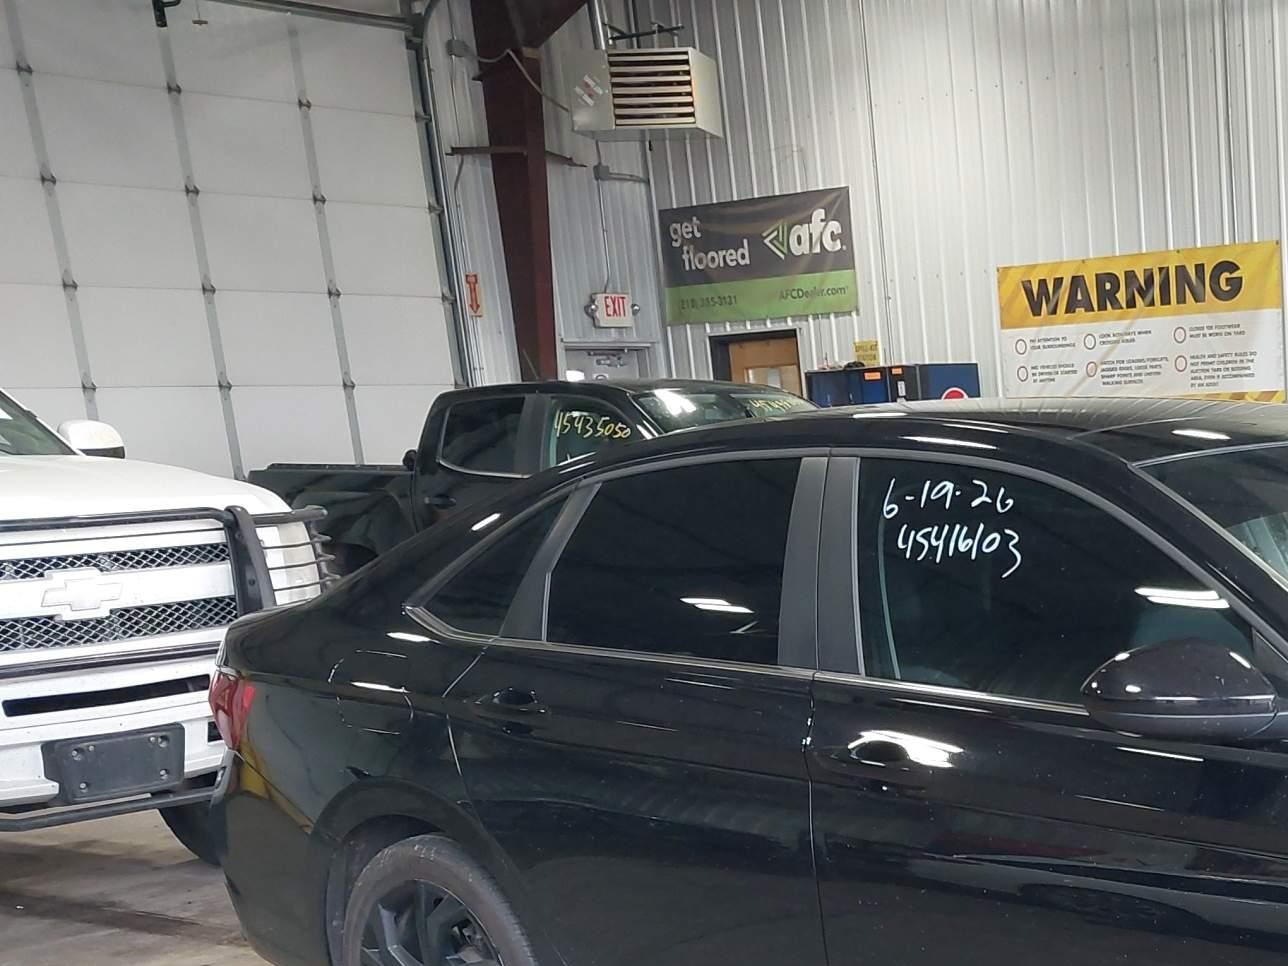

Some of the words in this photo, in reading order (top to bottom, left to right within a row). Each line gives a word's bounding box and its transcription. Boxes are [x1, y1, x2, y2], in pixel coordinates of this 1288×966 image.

[669, 216, 702, 248] get
[682, 238, 750, 271] floored
[1021, 260, 1243, 317] WARNING
[604, 296, 626, 317] EXIT
[554, 409, 631, 438] 45435050
[898, 523, 1022, 578] 45416103
